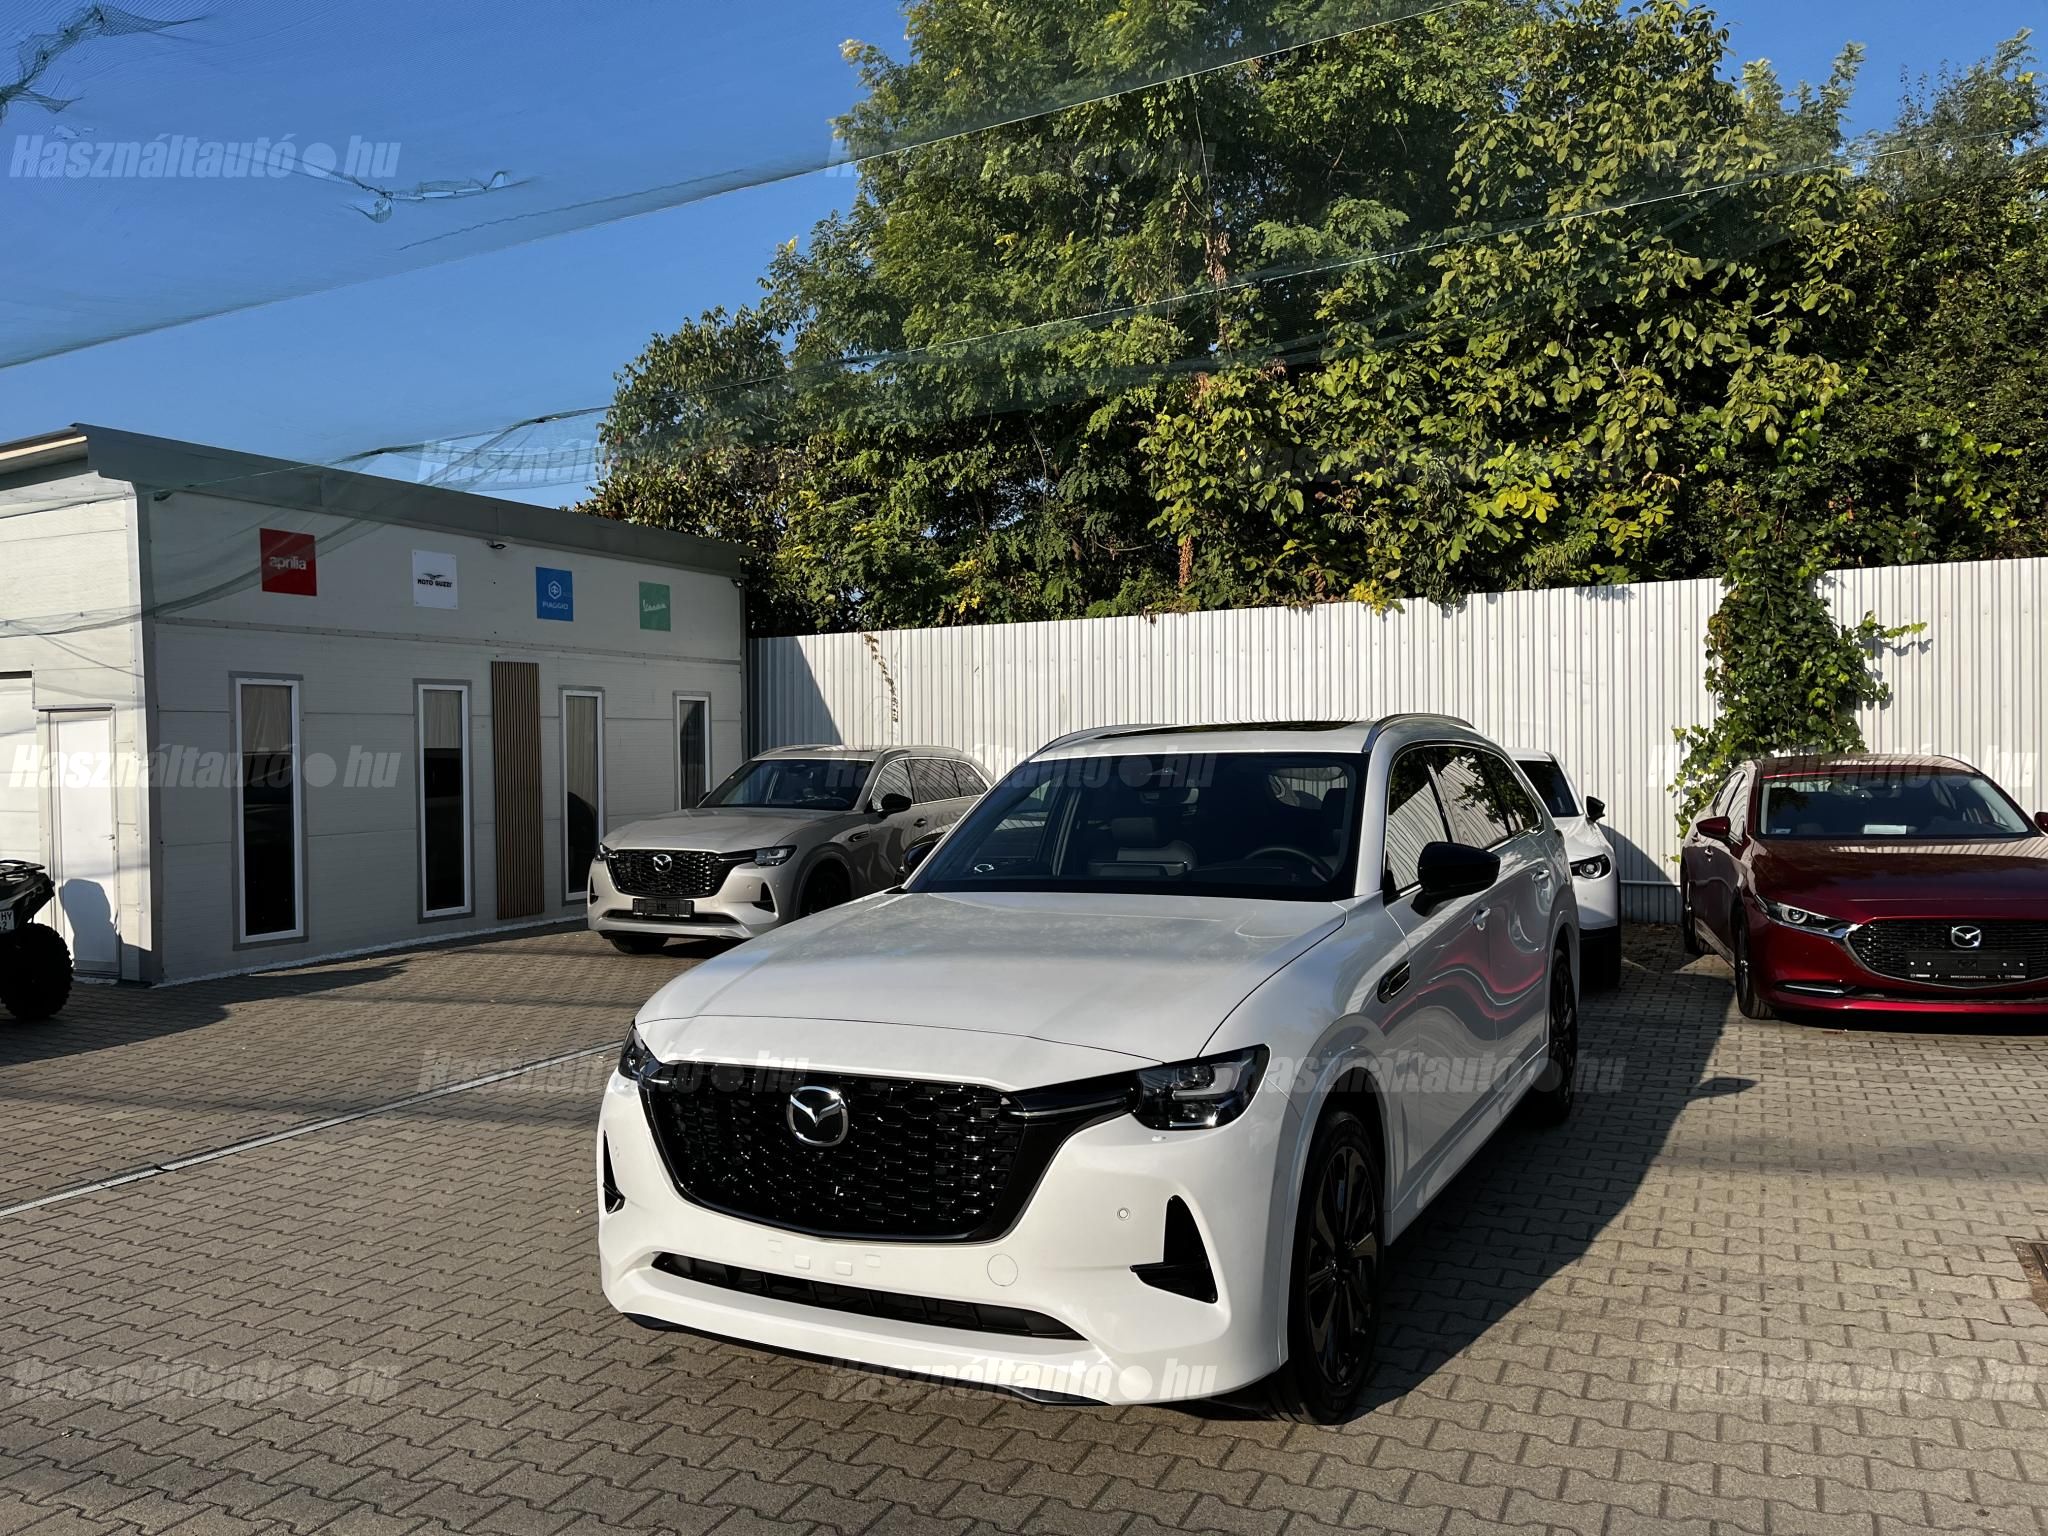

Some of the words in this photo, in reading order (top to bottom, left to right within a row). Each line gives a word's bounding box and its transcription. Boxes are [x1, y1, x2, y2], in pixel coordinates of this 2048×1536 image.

[269, 556, 307, 571] aprilia
[435, 580, 452, 588] GUZZI
[542, 601, 569, 610] PIAGGIO
